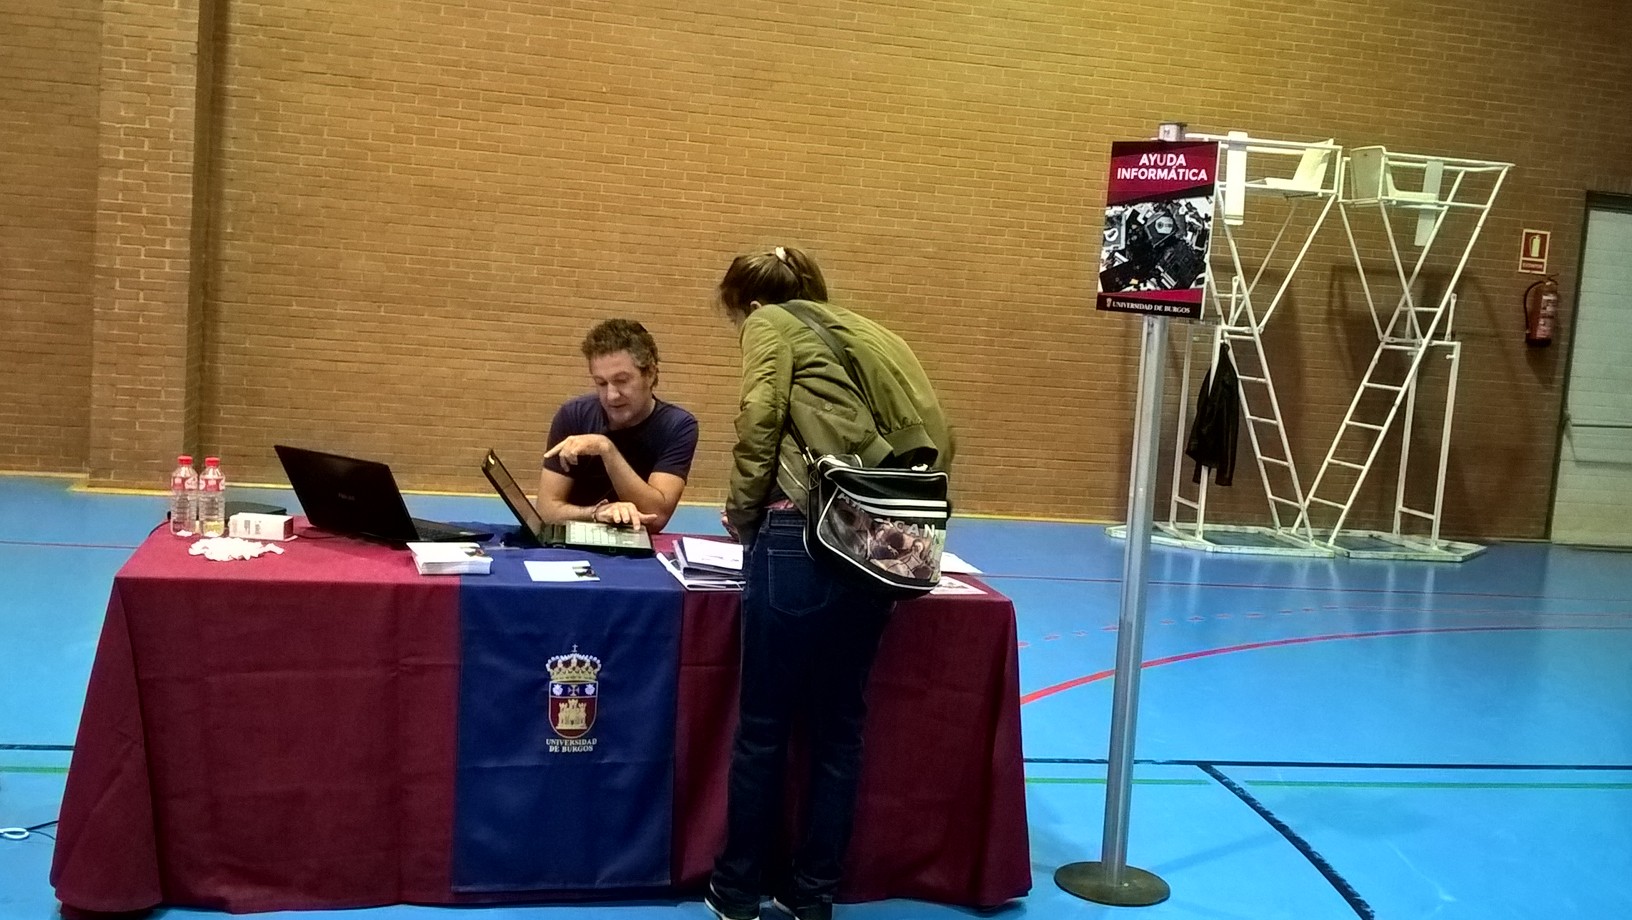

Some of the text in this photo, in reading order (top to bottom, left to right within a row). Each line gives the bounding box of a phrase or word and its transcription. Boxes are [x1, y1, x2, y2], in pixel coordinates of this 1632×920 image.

[1139, 153, 1187, 166] AYUDA
[1117, 165, 1208, 181] INFORMÁTICA
[1112, 301, 1191, 314] UNIVERSIDAD DE BURGOS
[545, 738, 598, 746] UNIVERSIDAD
[549, 745, 594, 753] DE BURGOS
